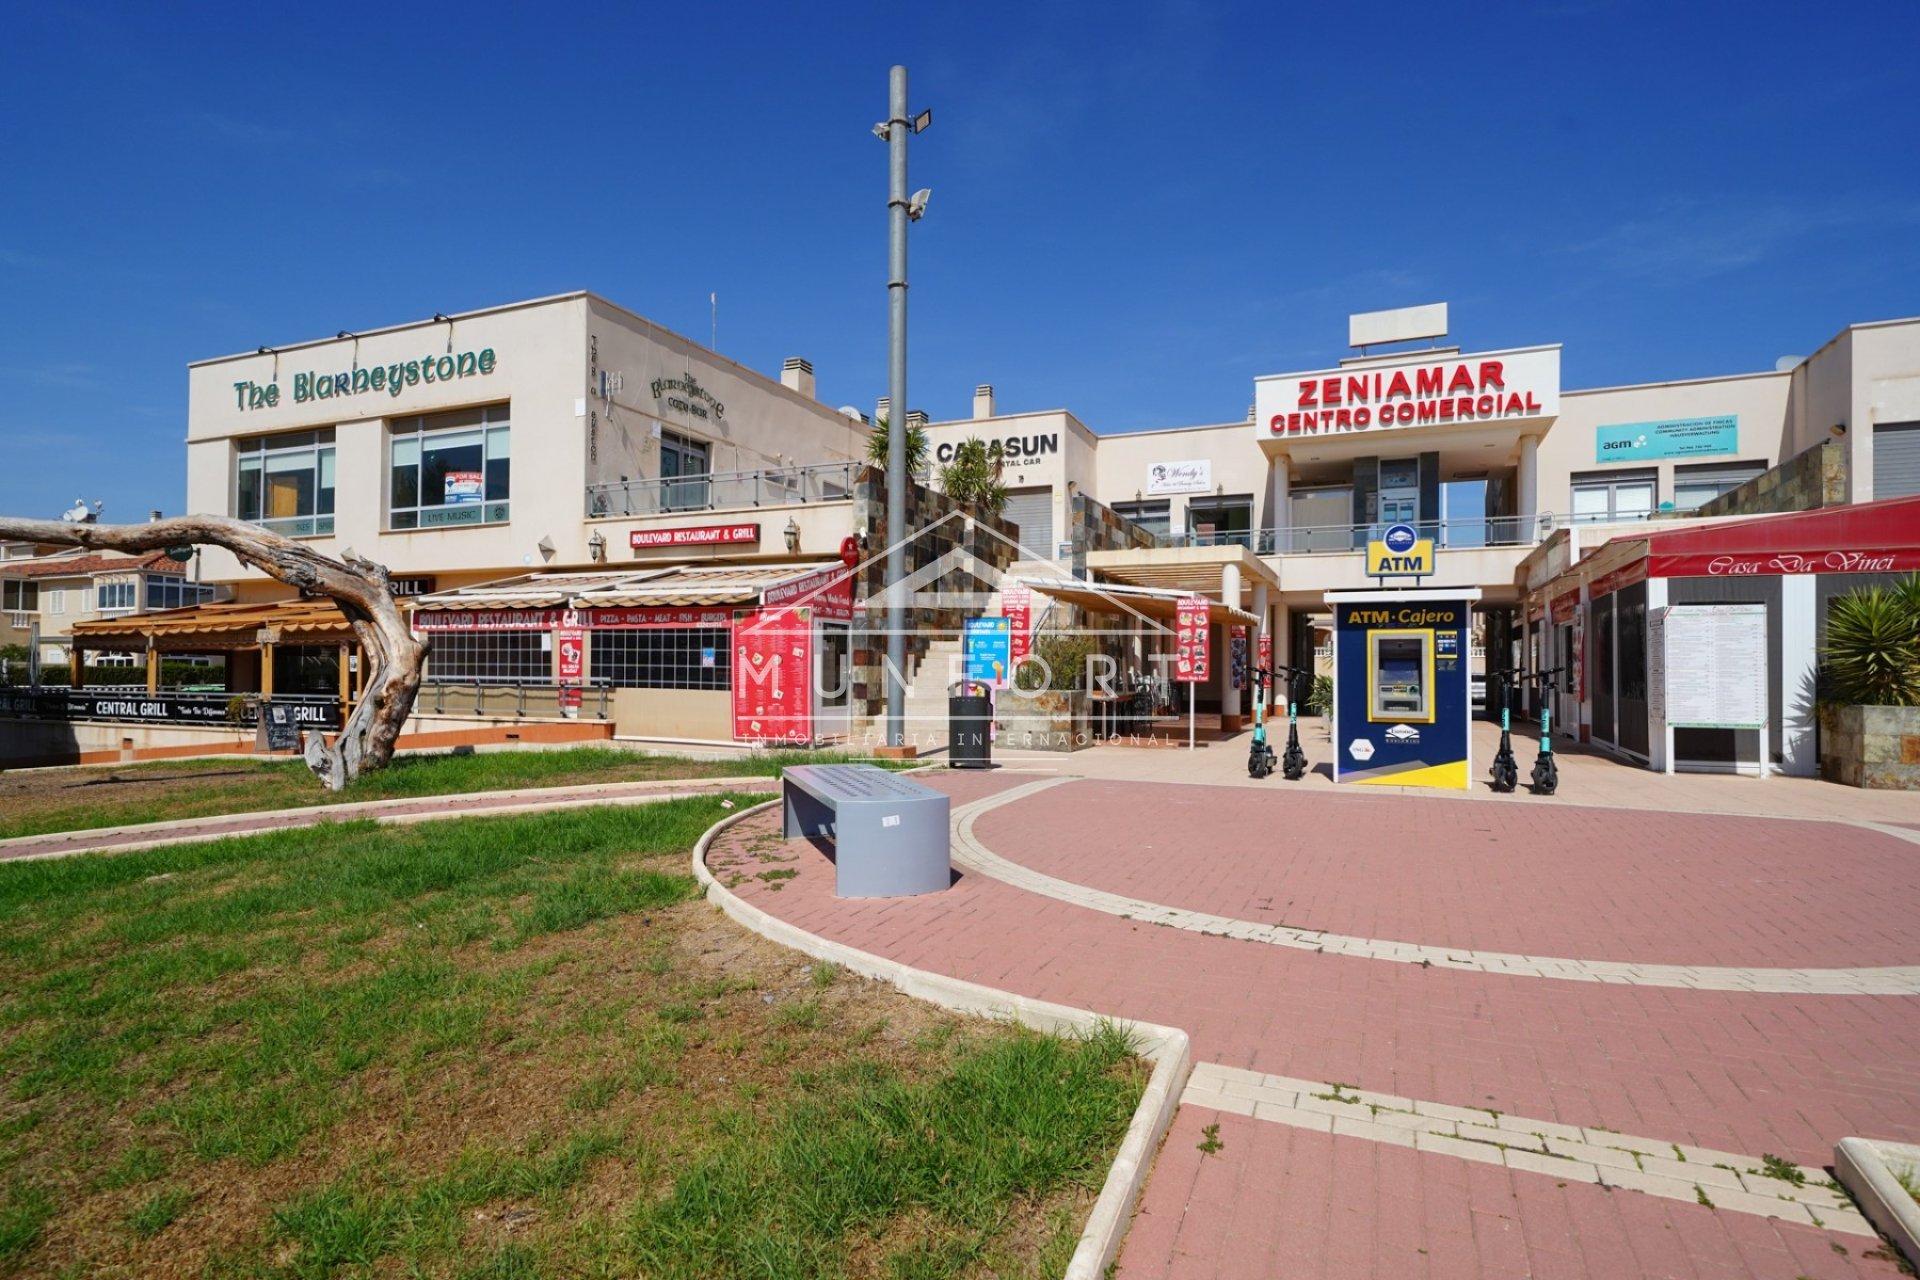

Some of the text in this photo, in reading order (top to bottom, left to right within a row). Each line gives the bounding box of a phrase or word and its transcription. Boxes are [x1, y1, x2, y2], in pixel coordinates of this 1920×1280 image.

[233, 348, 498, 411] The Blarneystone
[1298, 360, 1506, 406] ZENIAMAR
[1270, 391, 1542, 434] CENTRO COMERCIAL
[936, 433, 1058, 463] CAASUN
[1023, 458, 1041, 466] CAR
[447, 510, 476, 521] MUSIC
[632, 528, 754, 544] BOULEVARD RESTAURANT & GRILL
[1378, 556, 1423, 572] ATM
[1707, 551, 1896, 575] Casa Da Vinci
[389, 581, 423, 595] RILL
[418, 610, 594, 629] BOULEVARD RESTAURANT & GRILL
[600, 614, 619, 623] PIZZA
[626, 613, 647, 623] PASTA
[654, 613, 671, 623] MEAT
[678, 613, 693, 622] FISH
[1348, 609, 1455, 625] ATM Cajero
[96, 701, 168, 717] CENTRAL GRILL
[295, 706, 327, 721] GRILL
